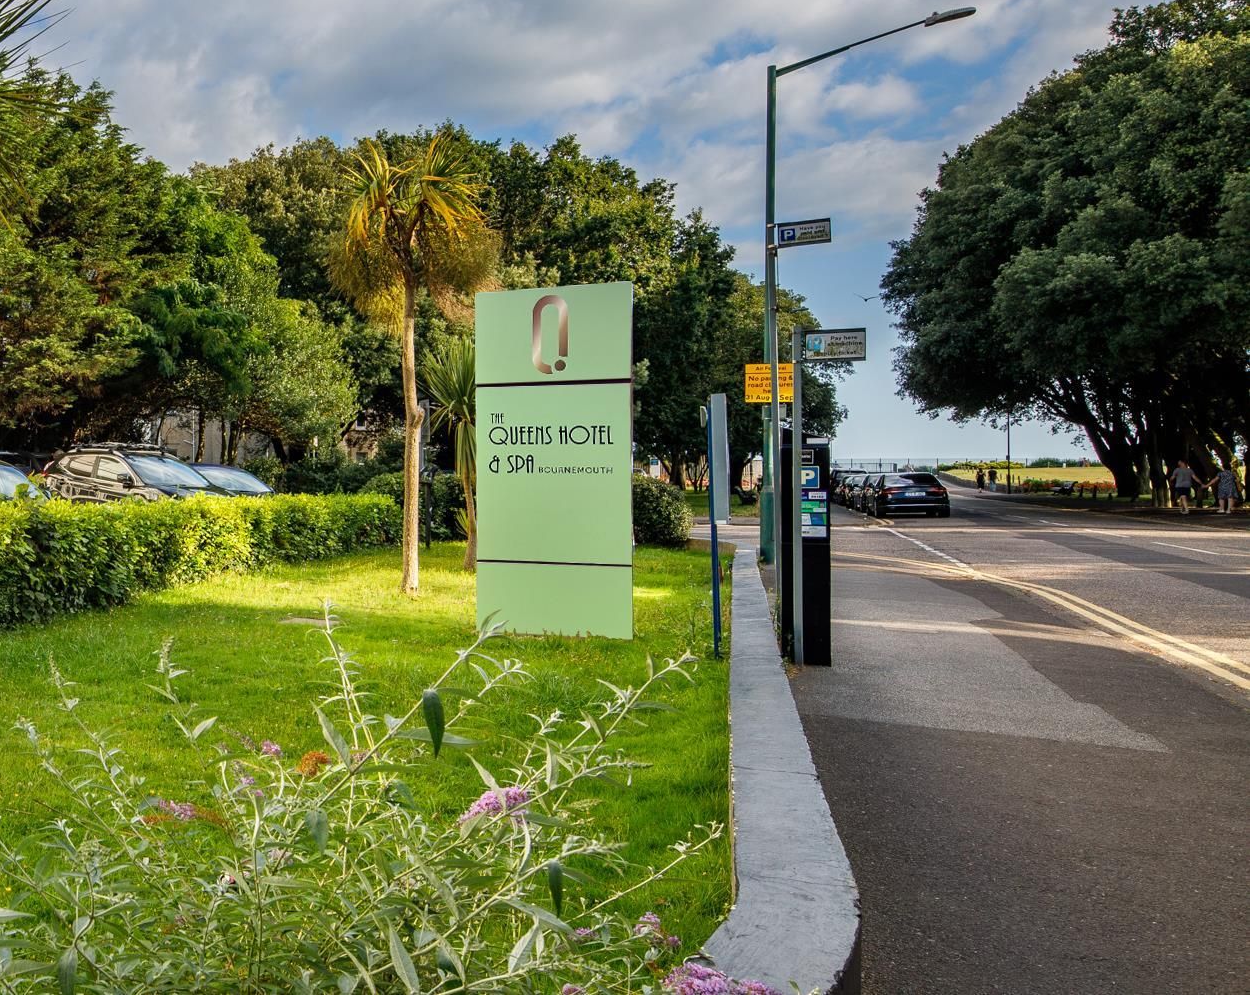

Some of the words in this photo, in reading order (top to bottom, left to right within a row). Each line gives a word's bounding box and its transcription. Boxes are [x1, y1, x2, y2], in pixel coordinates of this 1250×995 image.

[783, 230, 794, 241] P
[490, 413, 505, 424] THE
[488, 425, 553, 446] QUEENS
[558, 425, 614, 445] HOTEL
[488, 454, 501, 474] &
[506, 454, 535, 474] SPA
[538, 466, 614, 474] BOURNEMOUTH
[801, 470, 815, 485] P
